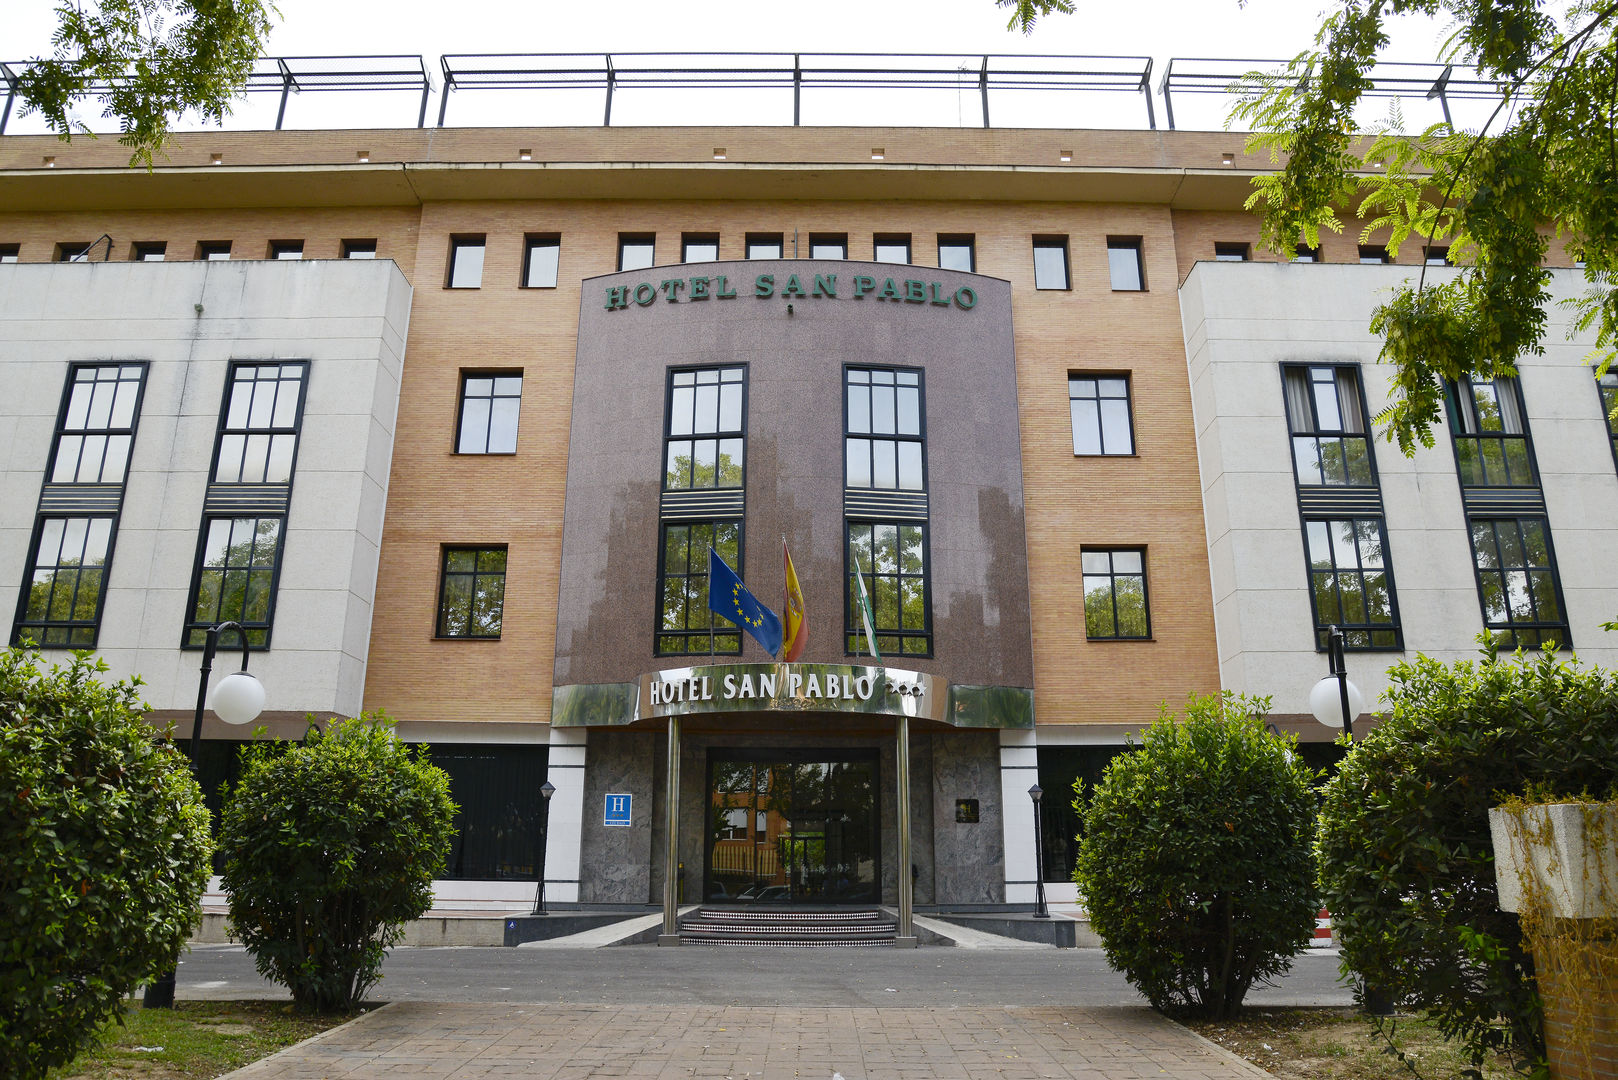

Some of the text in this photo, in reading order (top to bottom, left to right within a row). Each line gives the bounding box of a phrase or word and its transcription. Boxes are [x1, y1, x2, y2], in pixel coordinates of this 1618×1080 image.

[605, 274, 978, 310] HOTEL SAN PABLO
[650, 673, 875, 705] HOTEL SAN PABLO
[612, 797, 625, 812] H
